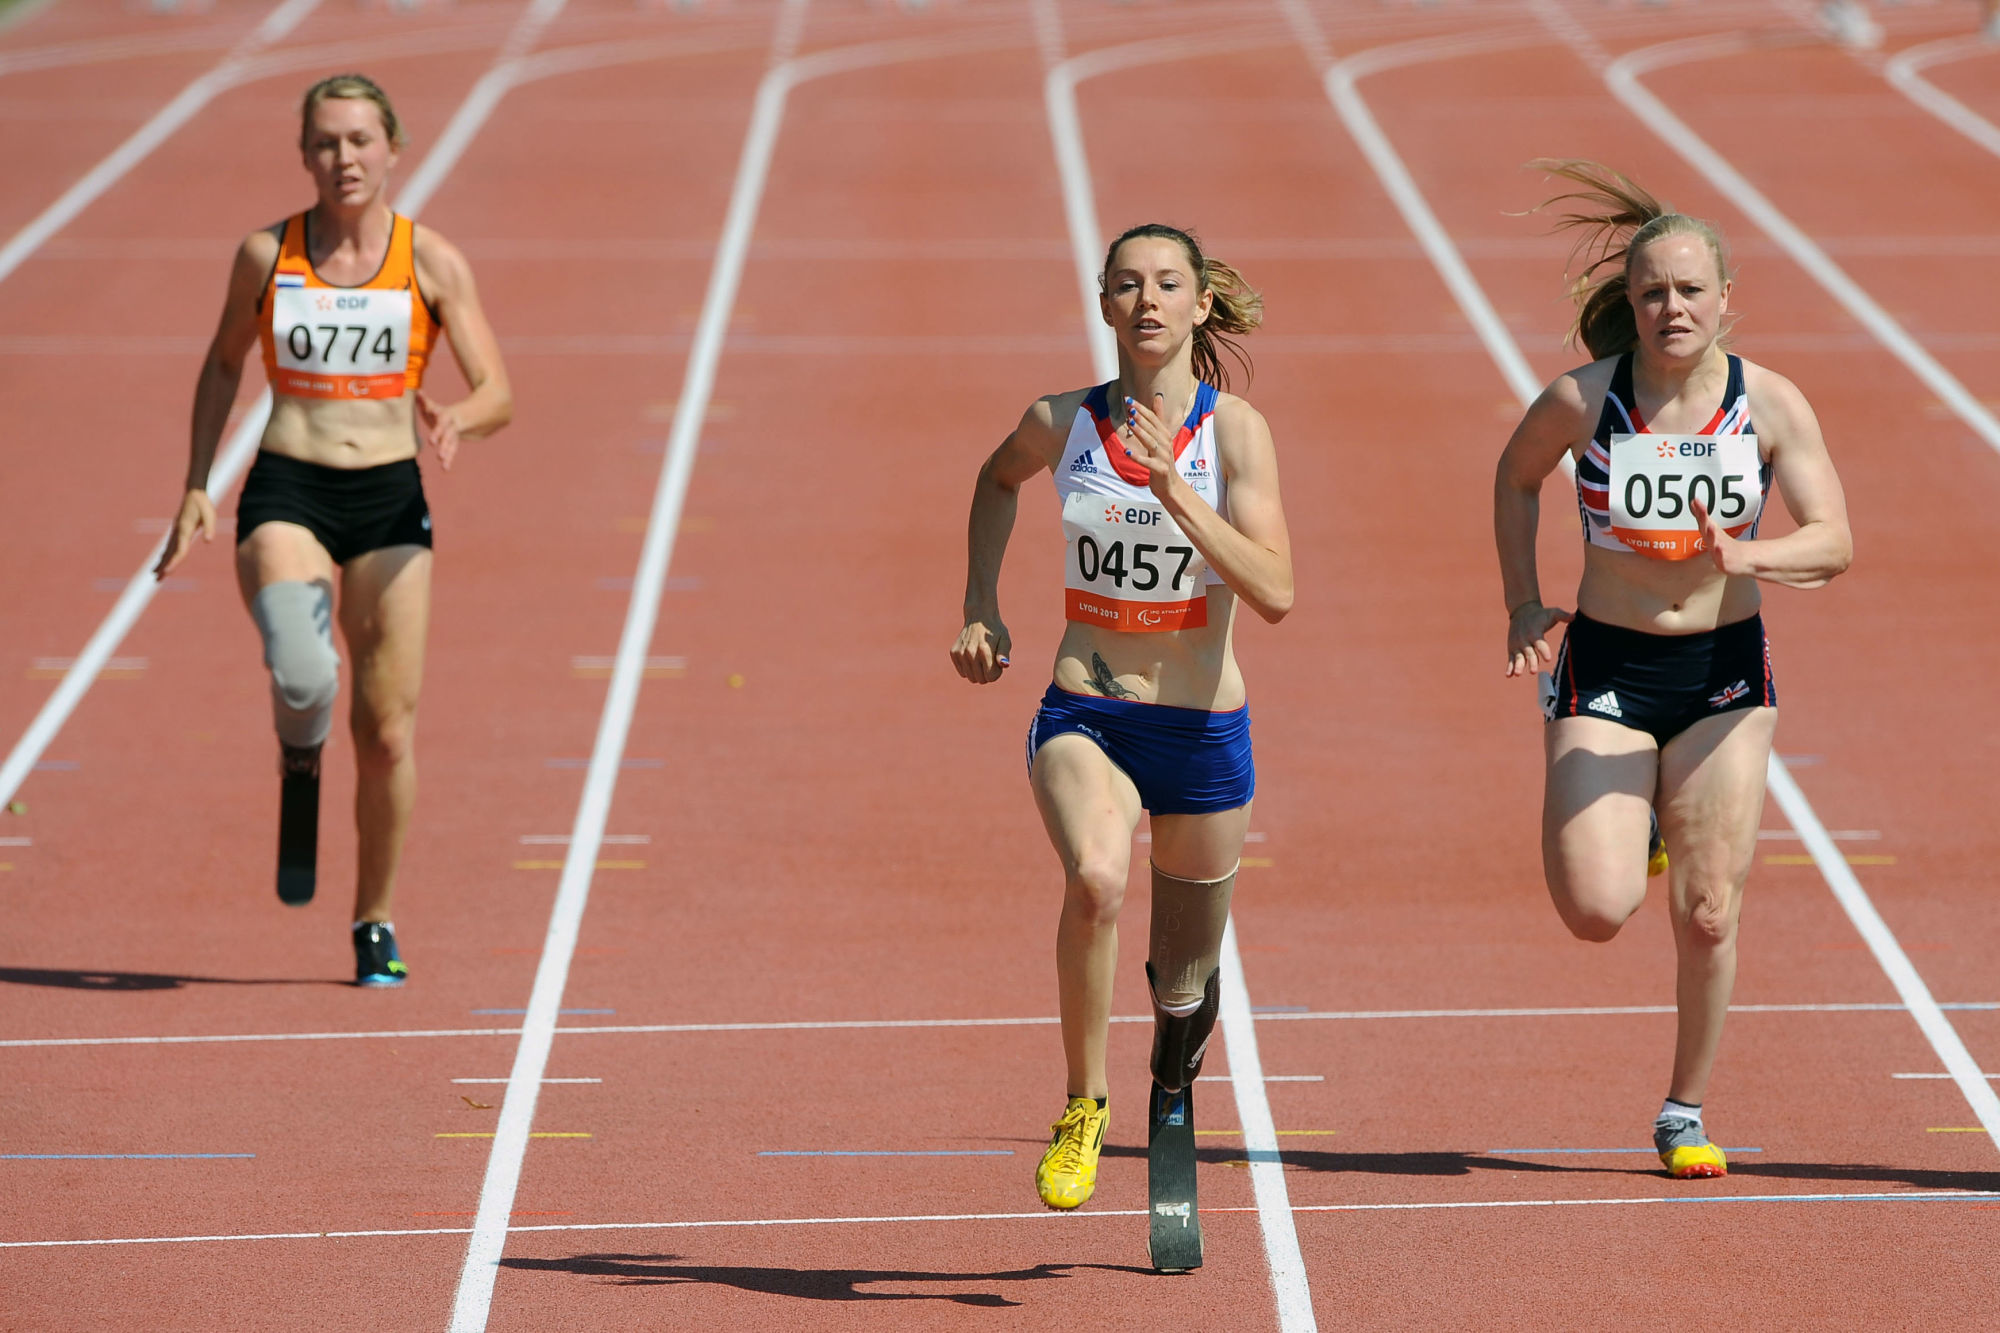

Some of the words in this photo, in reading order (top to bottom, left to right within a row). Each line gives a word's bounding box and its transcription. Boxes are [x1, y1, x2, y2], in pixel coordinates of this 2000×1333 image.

[287, 325, 396, 363] 0774
[1070, 462, 1098, 474] adidas
[1625, 473, 1746, 519] 0505
[1653, 541, 1676, 549] 2013
[1078, 535, 1193, 591] 0457
[1079, 602, 1098, 614] LYON
[1100, 607, 1119, 619] 2013
[1588, 701, 1622, 718] adidas
